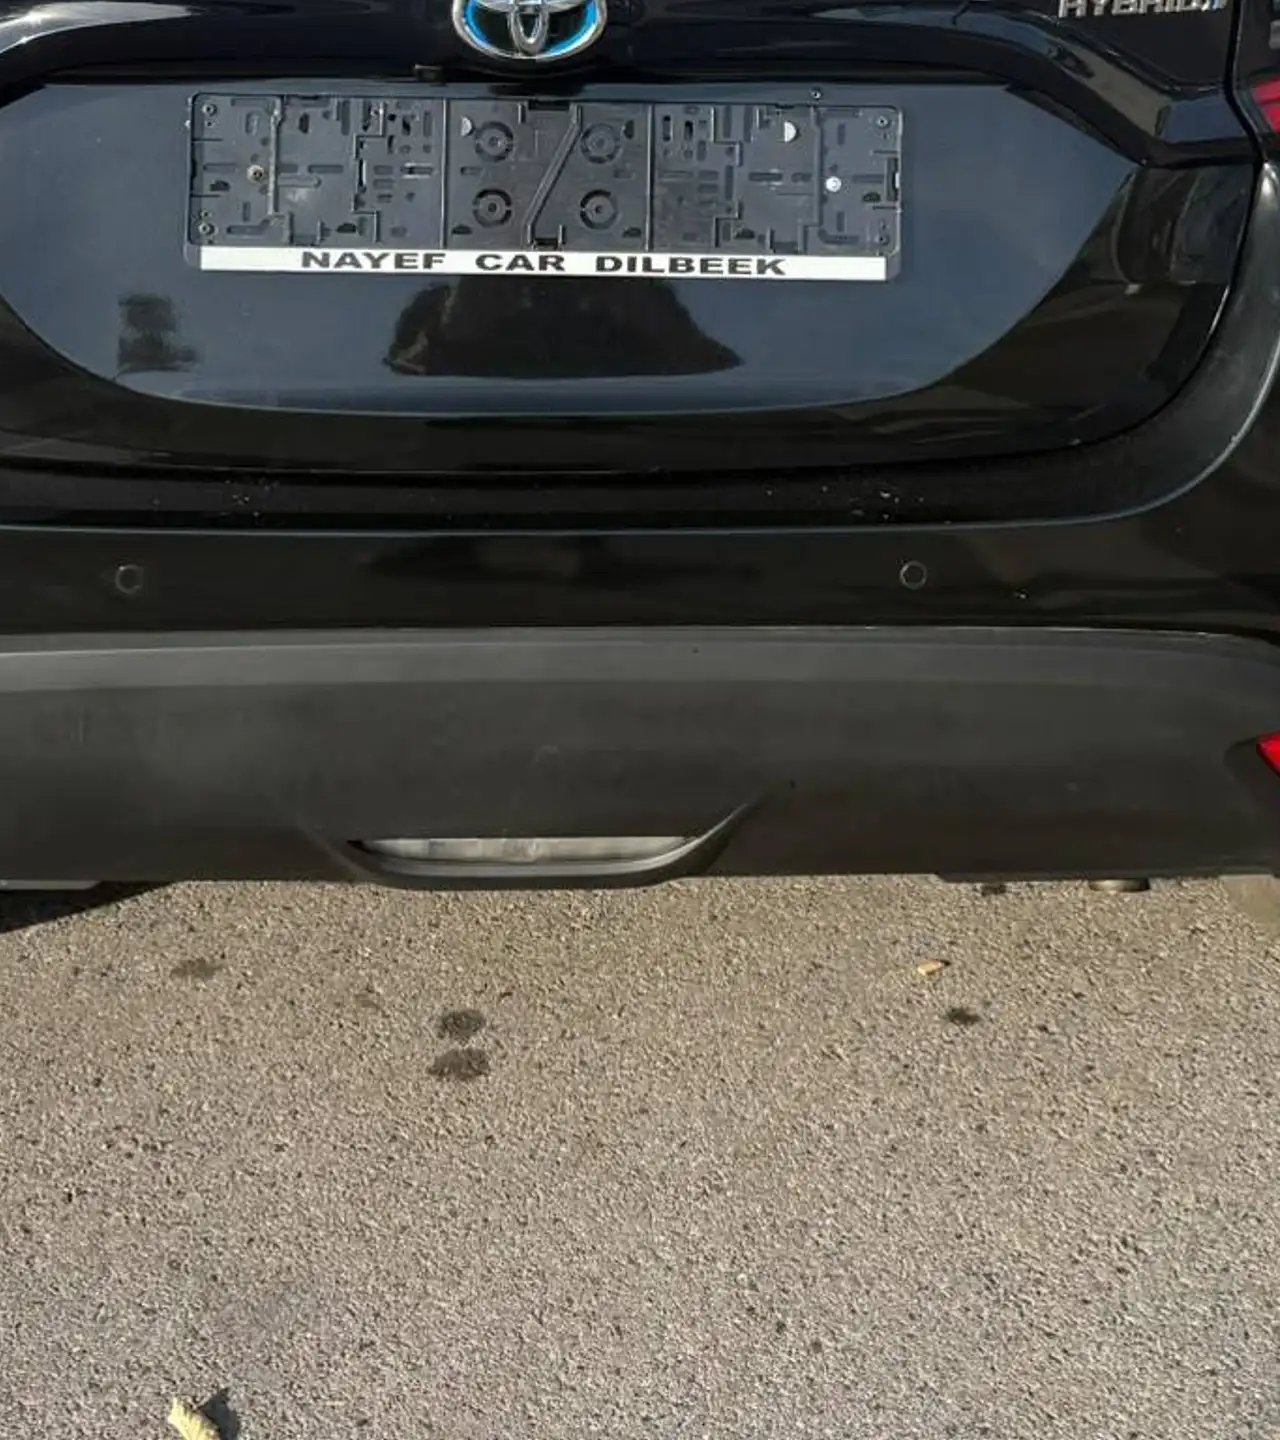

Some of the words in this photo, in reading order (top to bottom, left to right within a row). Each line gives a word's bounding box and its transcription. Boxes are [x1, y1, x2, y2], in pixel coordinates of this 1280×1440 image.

[301, 251, 445, 269] NAYEF
[475, 253, 565, 271] CAR
[595, 256, 786, 275] DILBEEK
